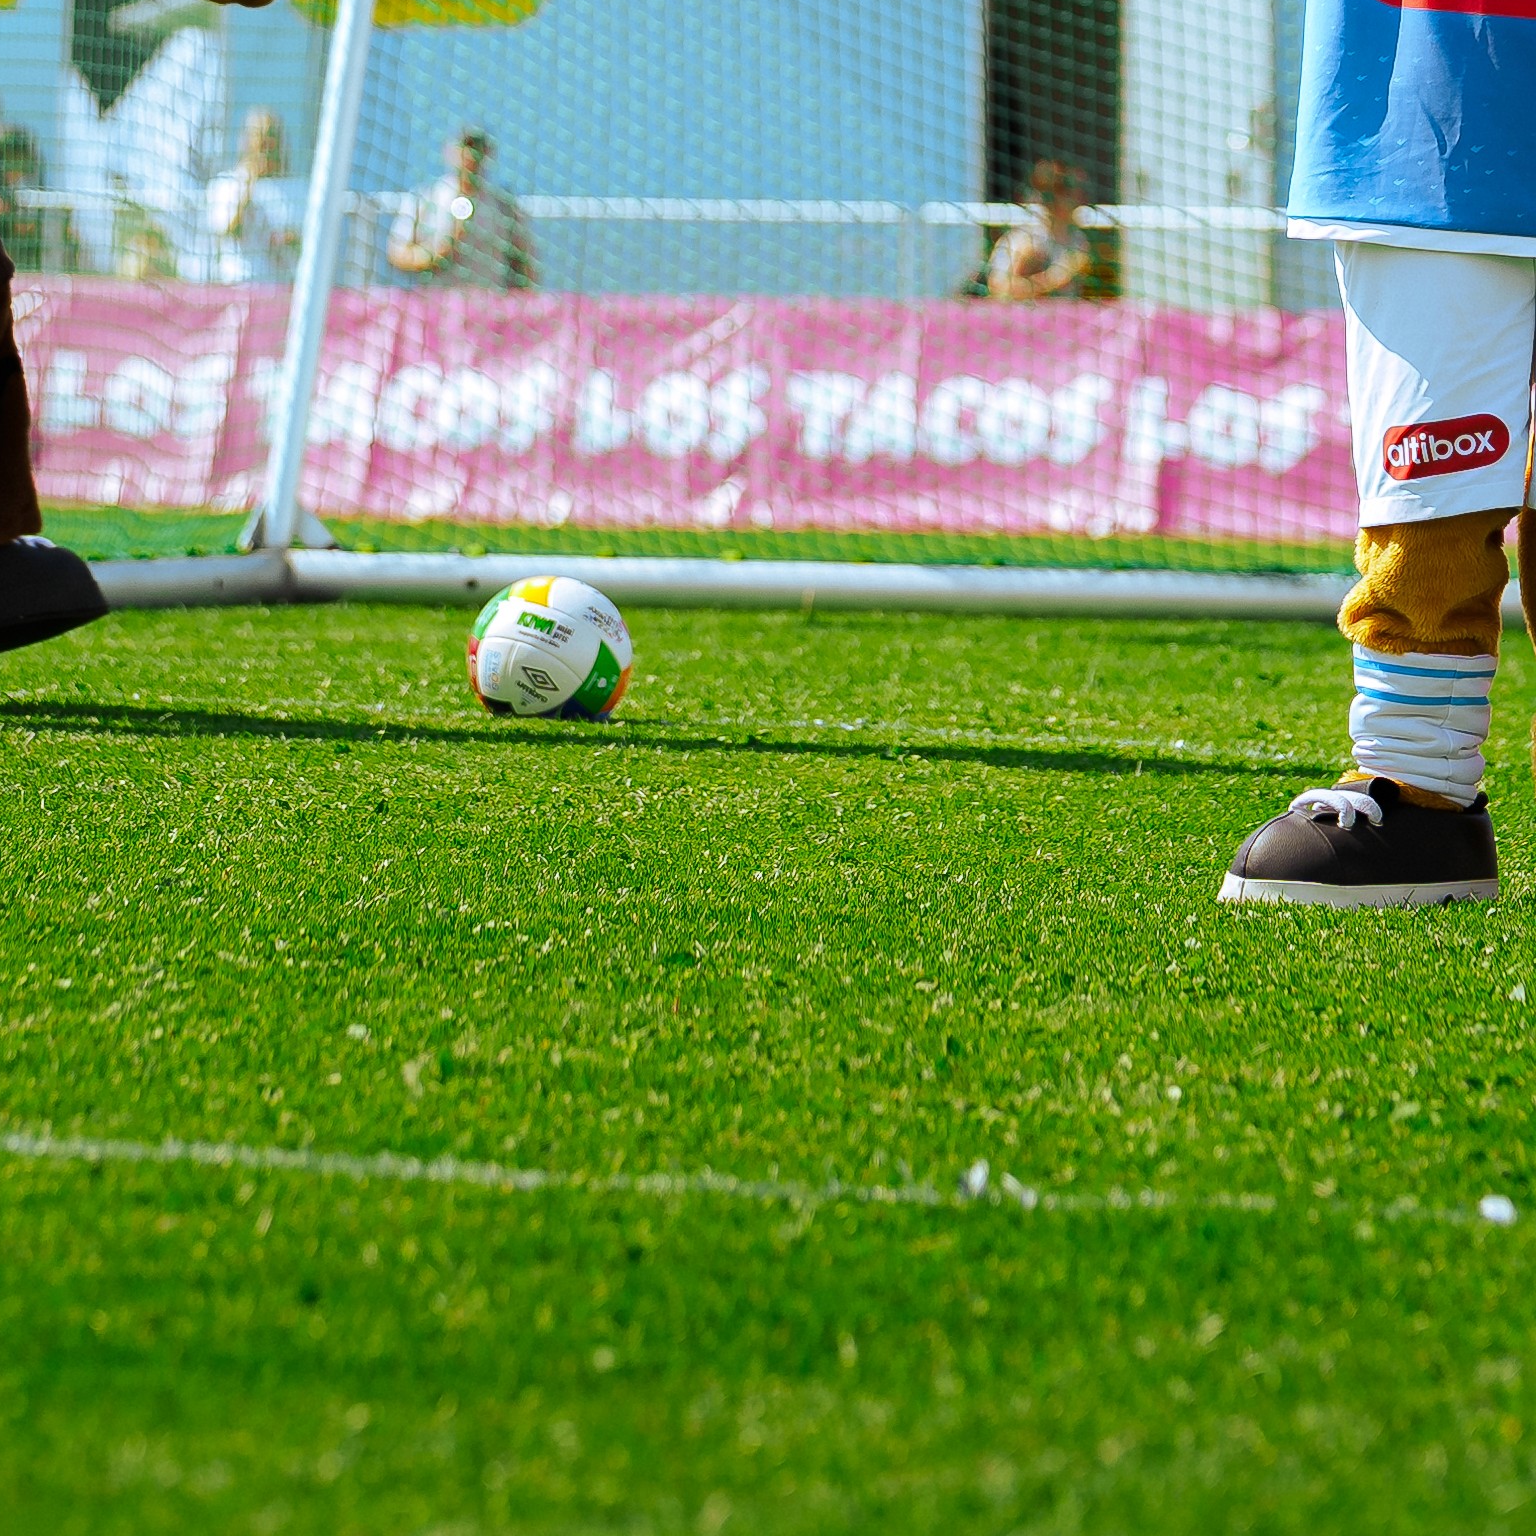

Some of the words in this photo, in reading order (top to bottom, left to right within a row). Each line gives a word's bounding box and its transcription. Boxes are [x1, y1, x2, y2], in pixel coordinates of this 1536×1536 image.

[786, 369, 1112, 465] TACOS
[1387, 430, 1496, 468] altibox
[517, 611, 558, 636] KIWI
